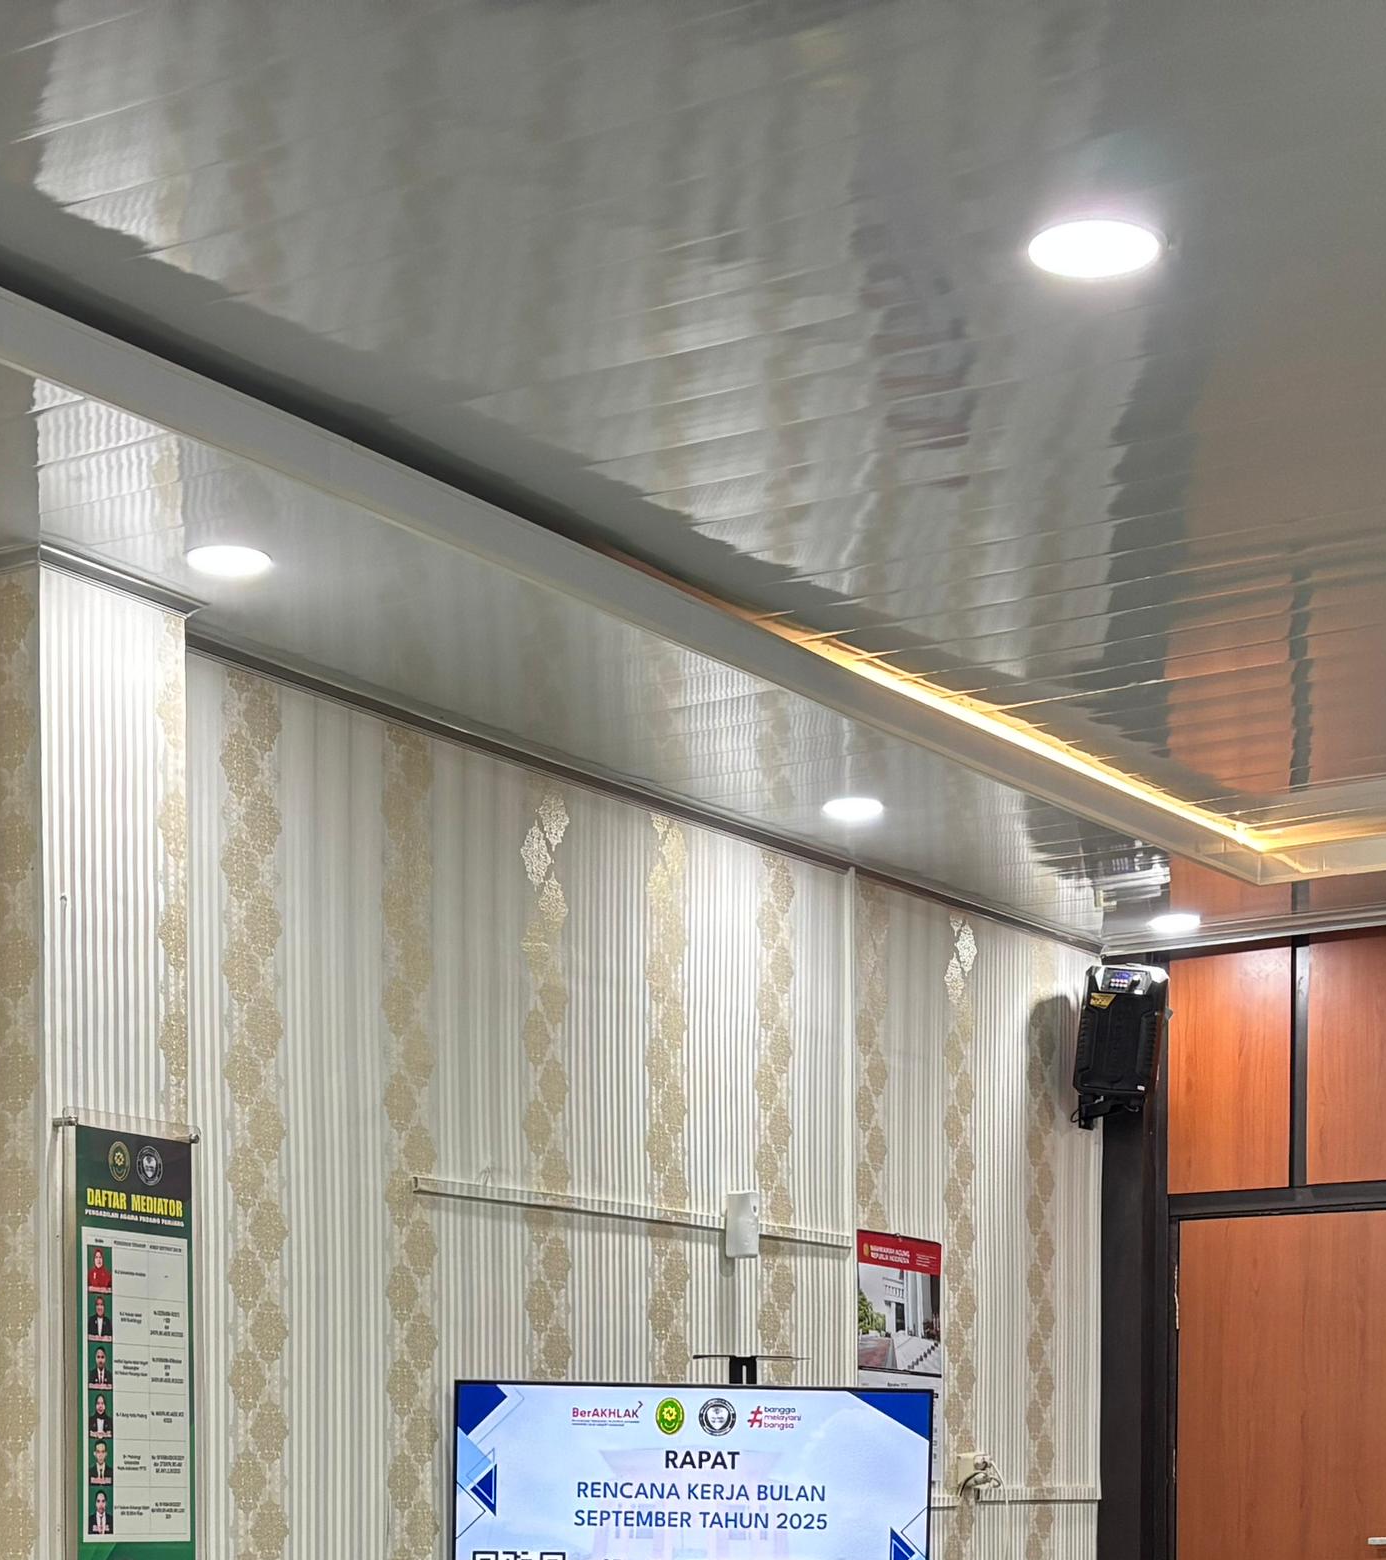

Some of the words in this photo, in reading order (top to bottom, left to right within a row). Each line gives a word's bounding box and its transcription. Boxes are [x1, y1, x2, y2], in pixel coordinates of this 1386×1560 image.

[86, 1187, 127, 1210] DAFTAR
[131, 1194, 183, 1218] MEDIATOR
[572, 1407, 639, 1418] BerAKHLAK
[764, 1406, 796, 1415] bangga
[764, 1422, 794, 1431] bangsa
[665, 1450, 740, 1470] RAPAT
[576, 1481, 680, 1500] RENCANA
[688, 1483, 750, 1501] KERJA
[757, 1485, 826, 1502] BULAN
[574, 1509, 692, 1528] SEPTEMBER
[699, 1511, 769, 1529] TAHUN
[776, 1513, 828, 1530] 2025
